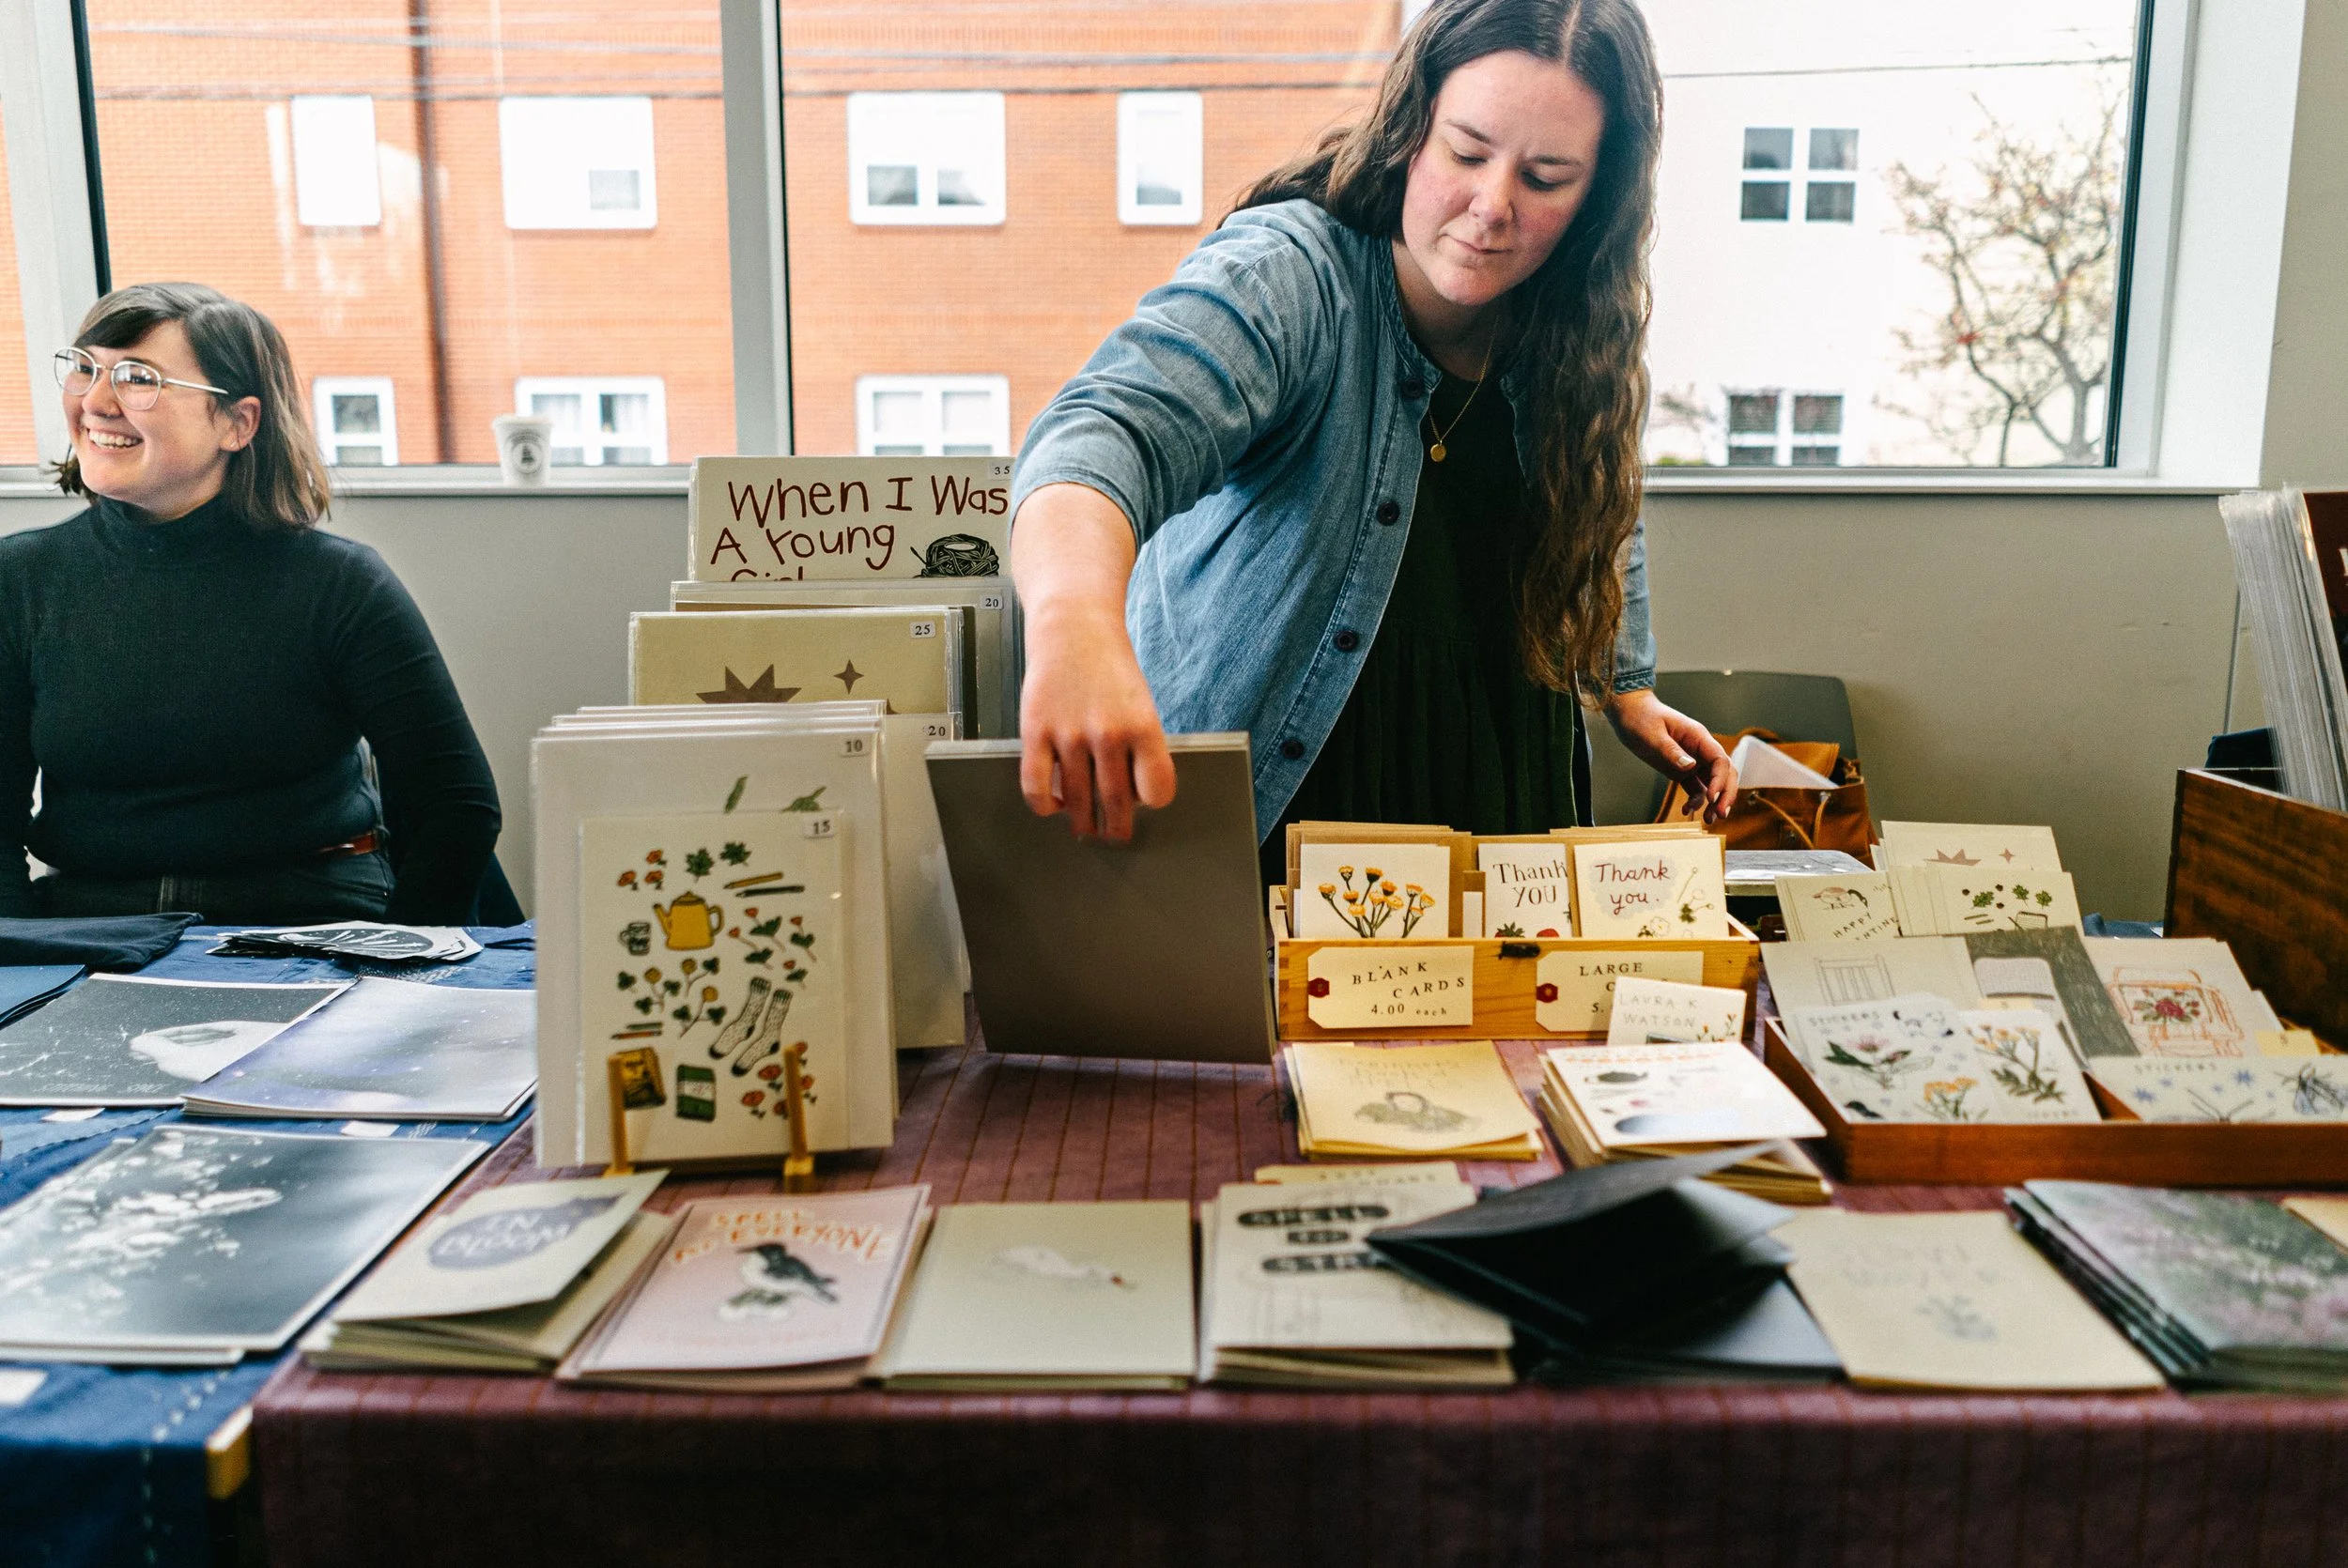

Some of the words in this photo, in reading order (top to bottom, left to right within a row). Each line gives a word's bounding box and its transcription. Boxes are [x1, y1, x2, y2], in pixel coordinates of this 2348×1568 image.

[994, 466, 1011, 475] 35
[728, 478, 870, 529] When
[885, 477, 914, 512] I
[931, 475, 1009, 515] Was
[710, 527, 749, 565] A
[765, 524, 895, 571] Young
[984, 597, 999, 608] 20
[914, 623, 932, 636] 25
[927, 725, 947, 737] 20
[846, 739, 863, 753] 10
[813, 820, 830, 835] 15
[1594, 859, 1671, 884] Thank
[1352, 961, 1428, 985] BLANK
[1579, 961, 1644, 976] LARGE
[1393, 976, 1465, 999] CARDS
[1370, 1003, 1405, 1015] 4.00
[1415, 1007, 1447, 1016] each
[1622, 1011, 1696, 1029] WATSON
